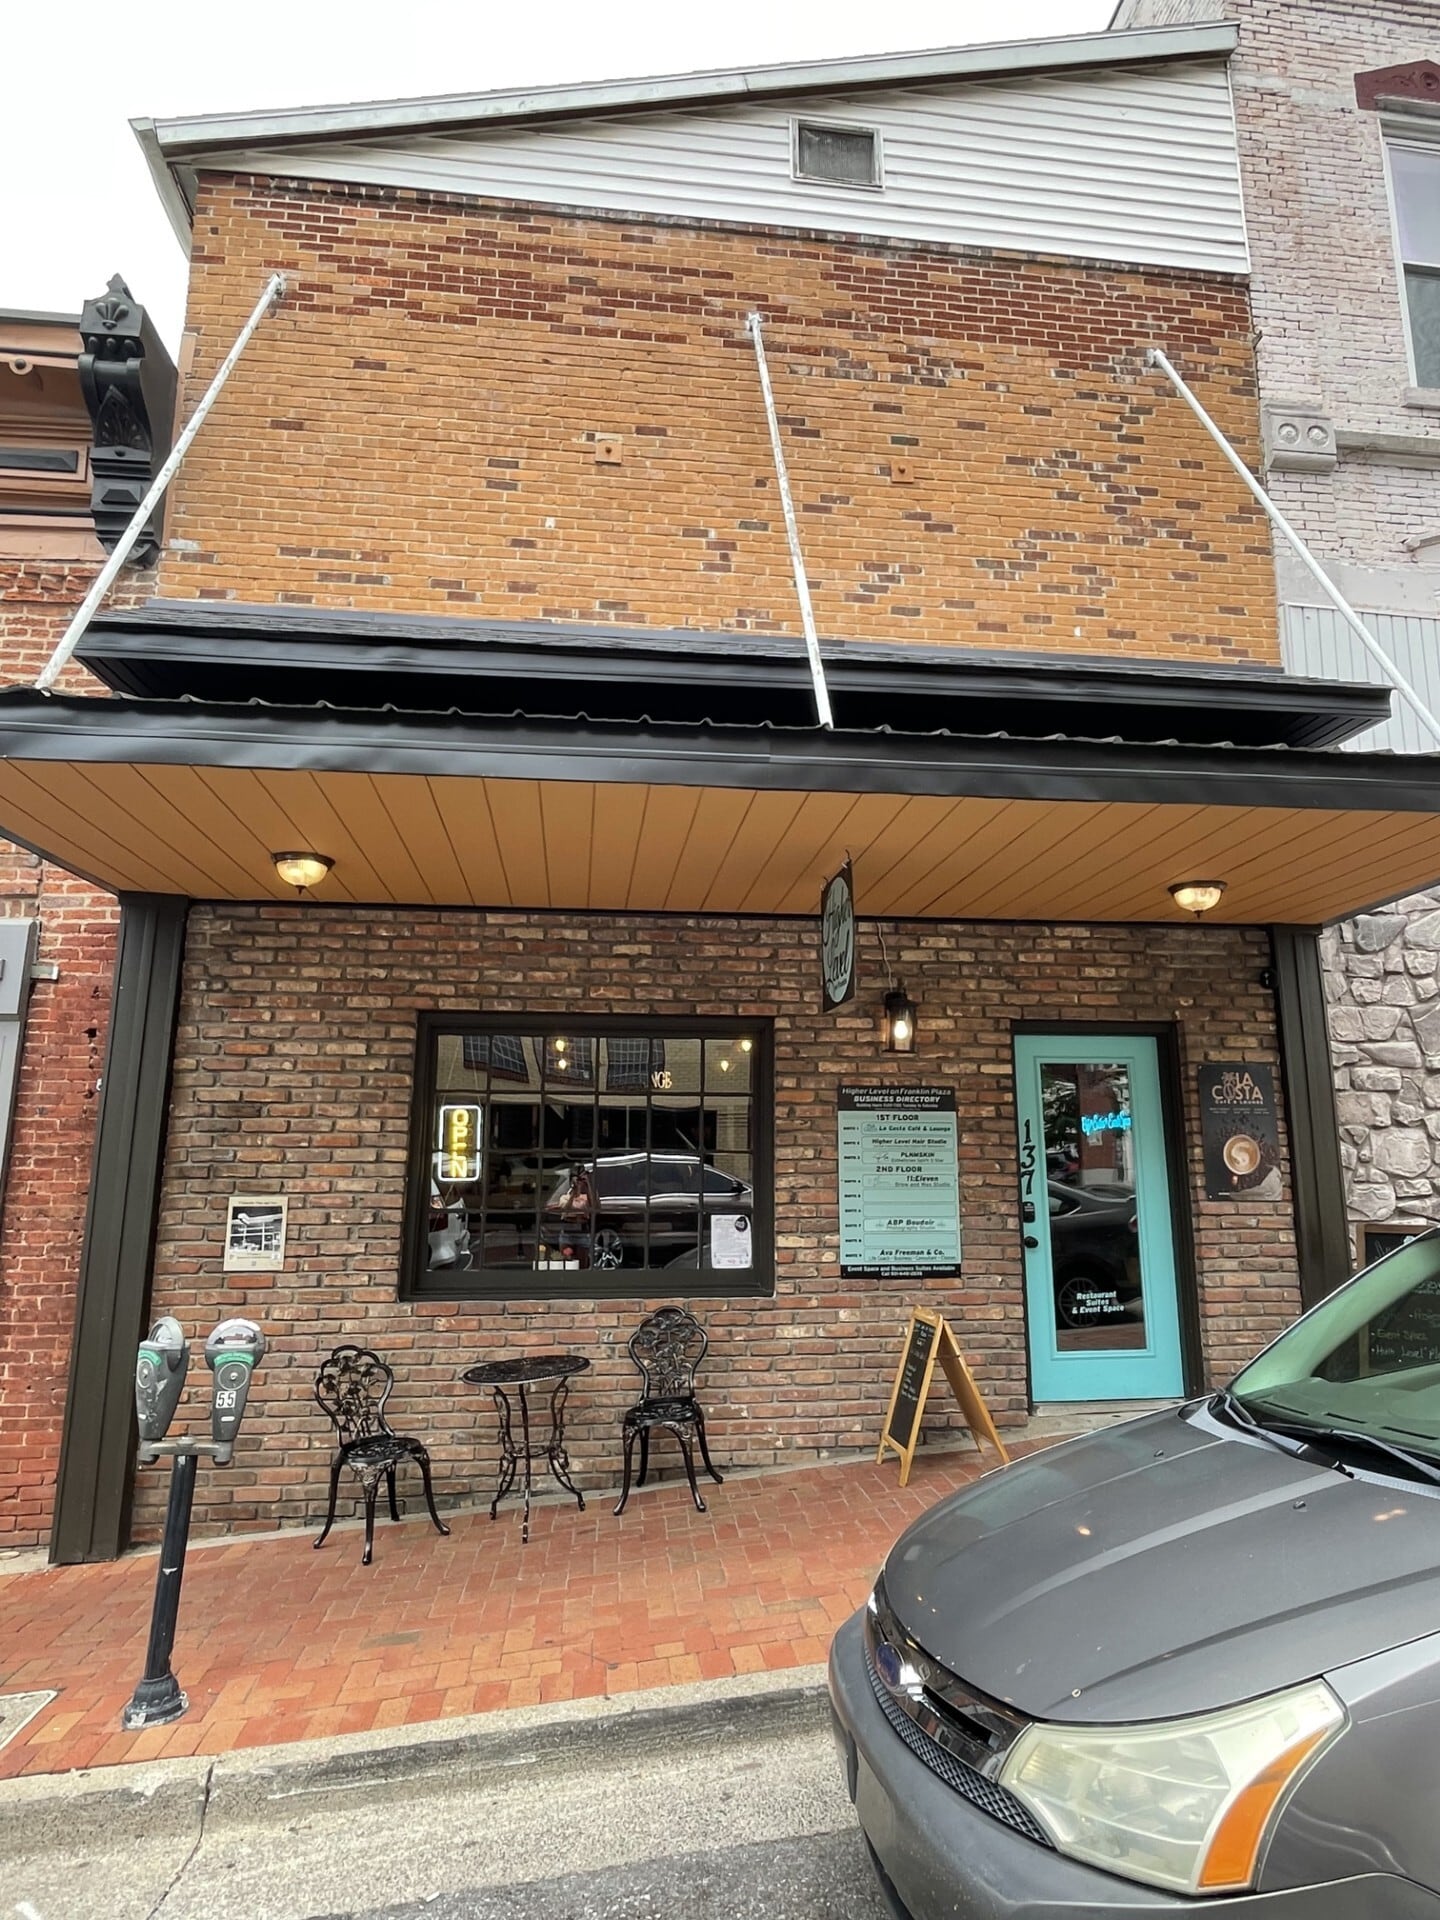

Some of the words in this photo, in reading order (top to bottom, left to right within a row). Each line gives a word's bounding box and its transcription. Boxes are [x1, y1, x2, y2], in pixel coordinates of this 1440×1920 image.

[842, 1087, 868, 1096] Higher
[869, 1087, 889, 1095] Level
[900, 1087, 930, 1095] Franklin
[931, 1087, 951, 1096] Plaza
[1211, 1085, 1263, 1100] COSTA
[853, 1095, 894, 1103] BUSINESS
[896, 1095, 941, 1103] DIRECTORY
[452, 1109, 469, 1177] OPEN
[1076, 1290, 1117, 1300] Restaurant
[1071, 1306, 1078, 1314] &
[1079, 1306, 1100, 1314] Event
[1103, 1305, 1125, 1313] Space
[217, 1392, 234, 1408] 55
